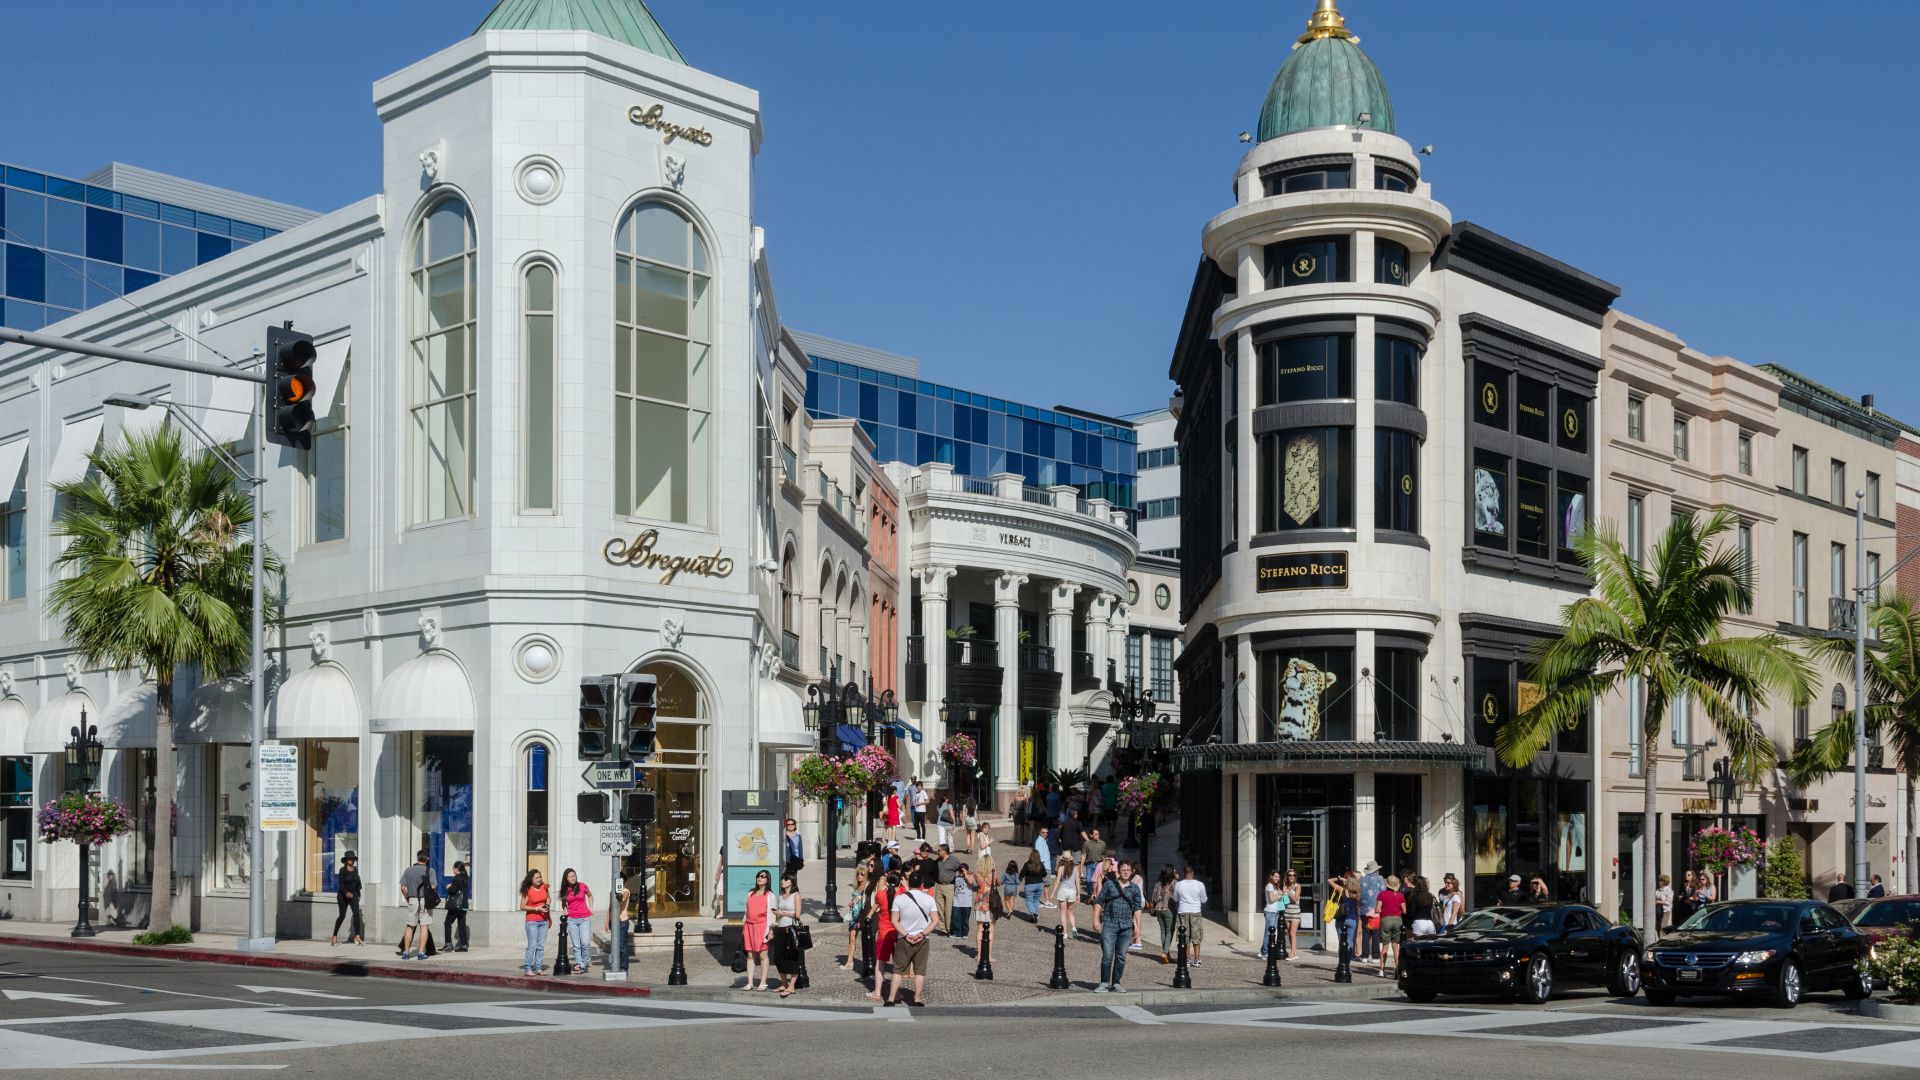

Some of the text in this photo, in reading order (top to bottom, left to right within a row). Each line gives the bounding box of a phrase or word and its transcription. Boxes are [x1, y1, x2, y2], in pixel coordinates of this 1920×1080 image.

[999, 533, 1032, 549] VERSACE
[602, 528, 733, 585] Breguet
[1260, 563, 1343, 579] STEFANO RICCI
[597, 769, 629, 780] ONE WAY
[675, 827, 691, 837] Getty
[602, 842, 612, 852] OK
